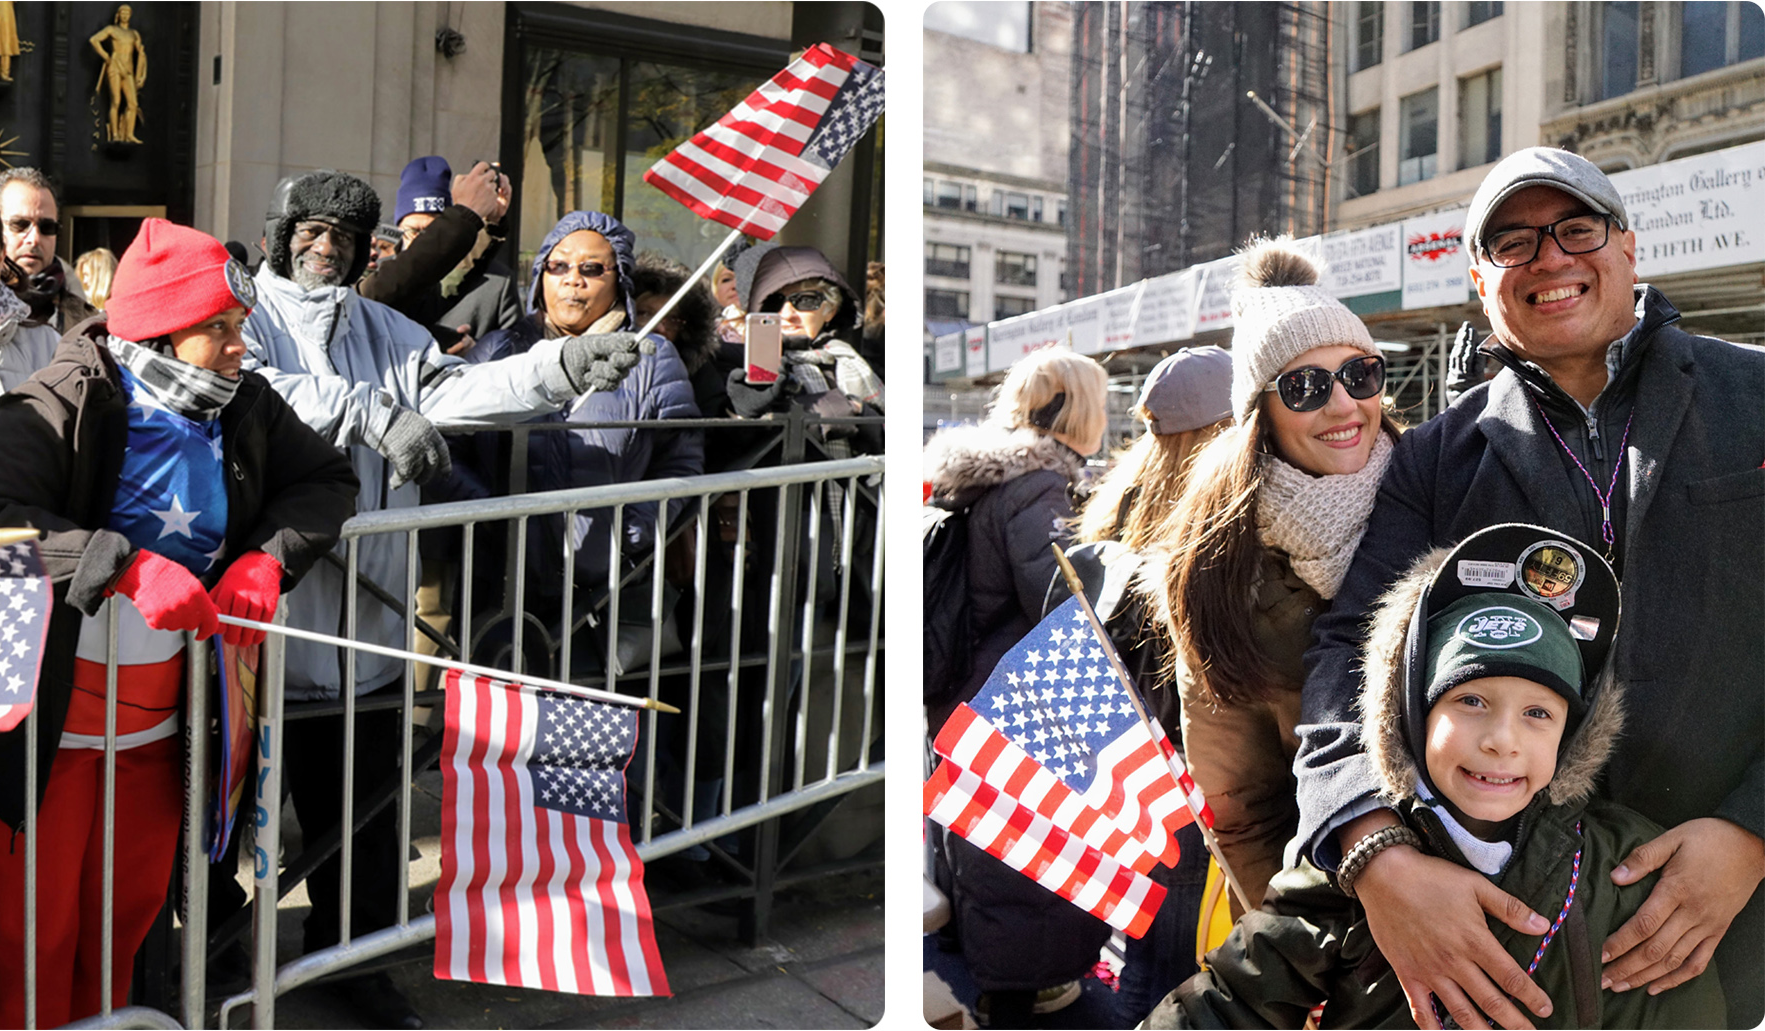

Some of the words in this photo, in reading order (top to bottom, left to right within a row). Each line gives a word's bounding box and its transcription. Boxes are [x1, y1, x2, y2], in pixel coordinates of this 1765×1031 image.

[1622, 182, 1685, 208] rrington
[1689, 168, 1752, 191] Gallery
[1632, 209, 1694, 231] London
[1699, 199, 1735, 221] Ltd.
[1410, 236, 1461, 254] ARSENAL
[1653, 237, 1703, 259] FIFTH
[1711, 230, 1751, 251] AVE.
[1468, 616, 1527, 632] JETS
[253, 724, 271, 880] NYPD
